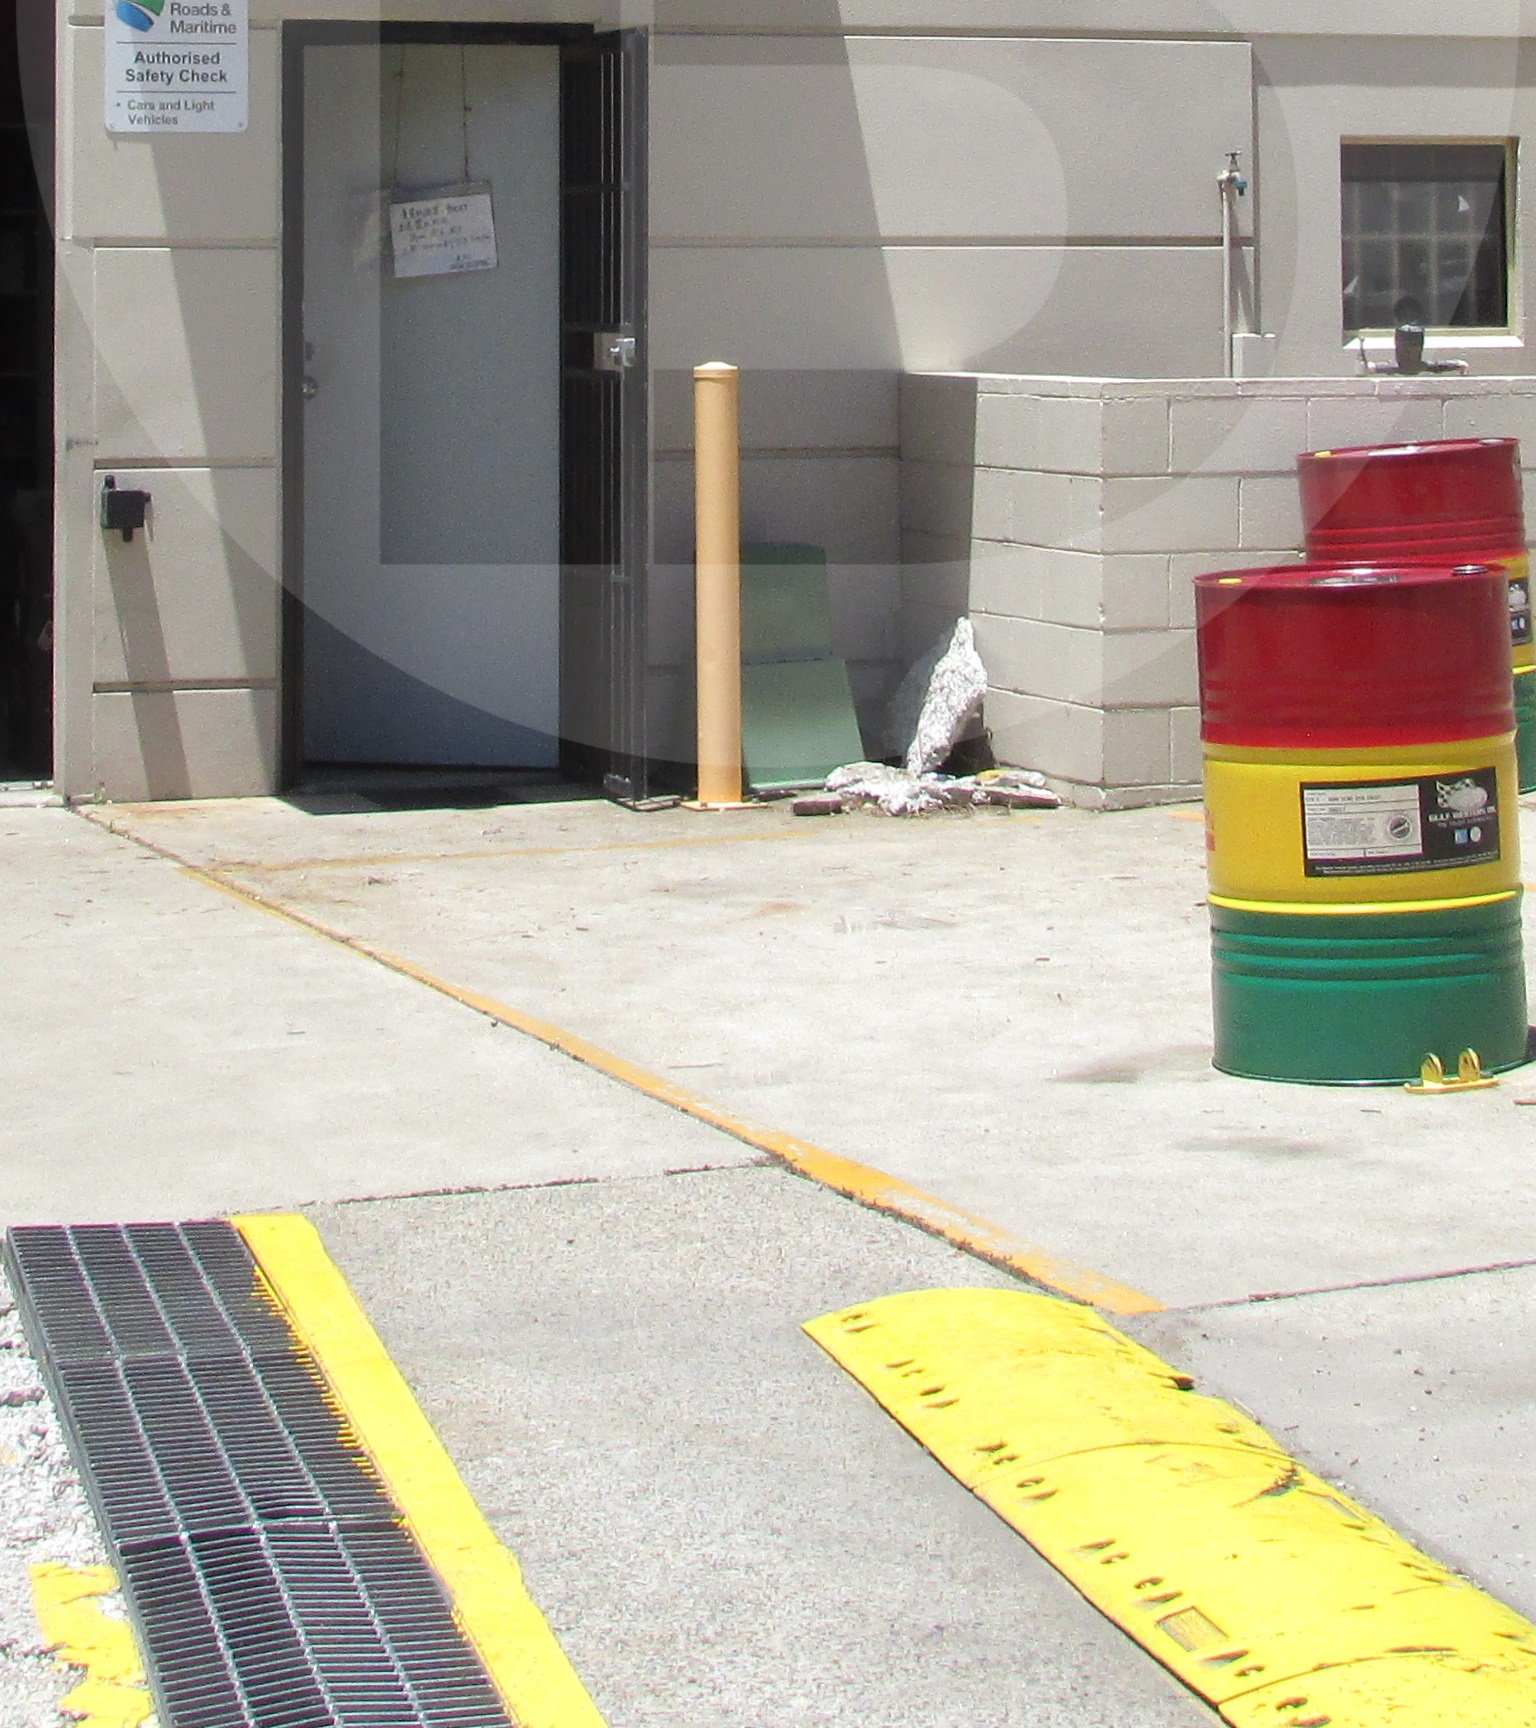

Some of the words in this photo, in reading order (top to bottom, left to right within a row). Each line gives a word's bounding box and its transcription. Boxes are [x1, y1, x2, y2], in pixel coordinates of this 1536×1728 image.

[170, 2, 218, 16] Roads
[221, 3, 231, 16] &
[170, 20, 237, 34] Maritime
[134, 51, 221, 65] Authorised
[125, 68, 174, 85] Safety
[179, 69, 228, 83] Check
[127, 99, 155, 111] Cars
[159, 99, 181, 111] and
[184, 99, 215, 113] Light
[127, 114, 179, 126] Vehicles
